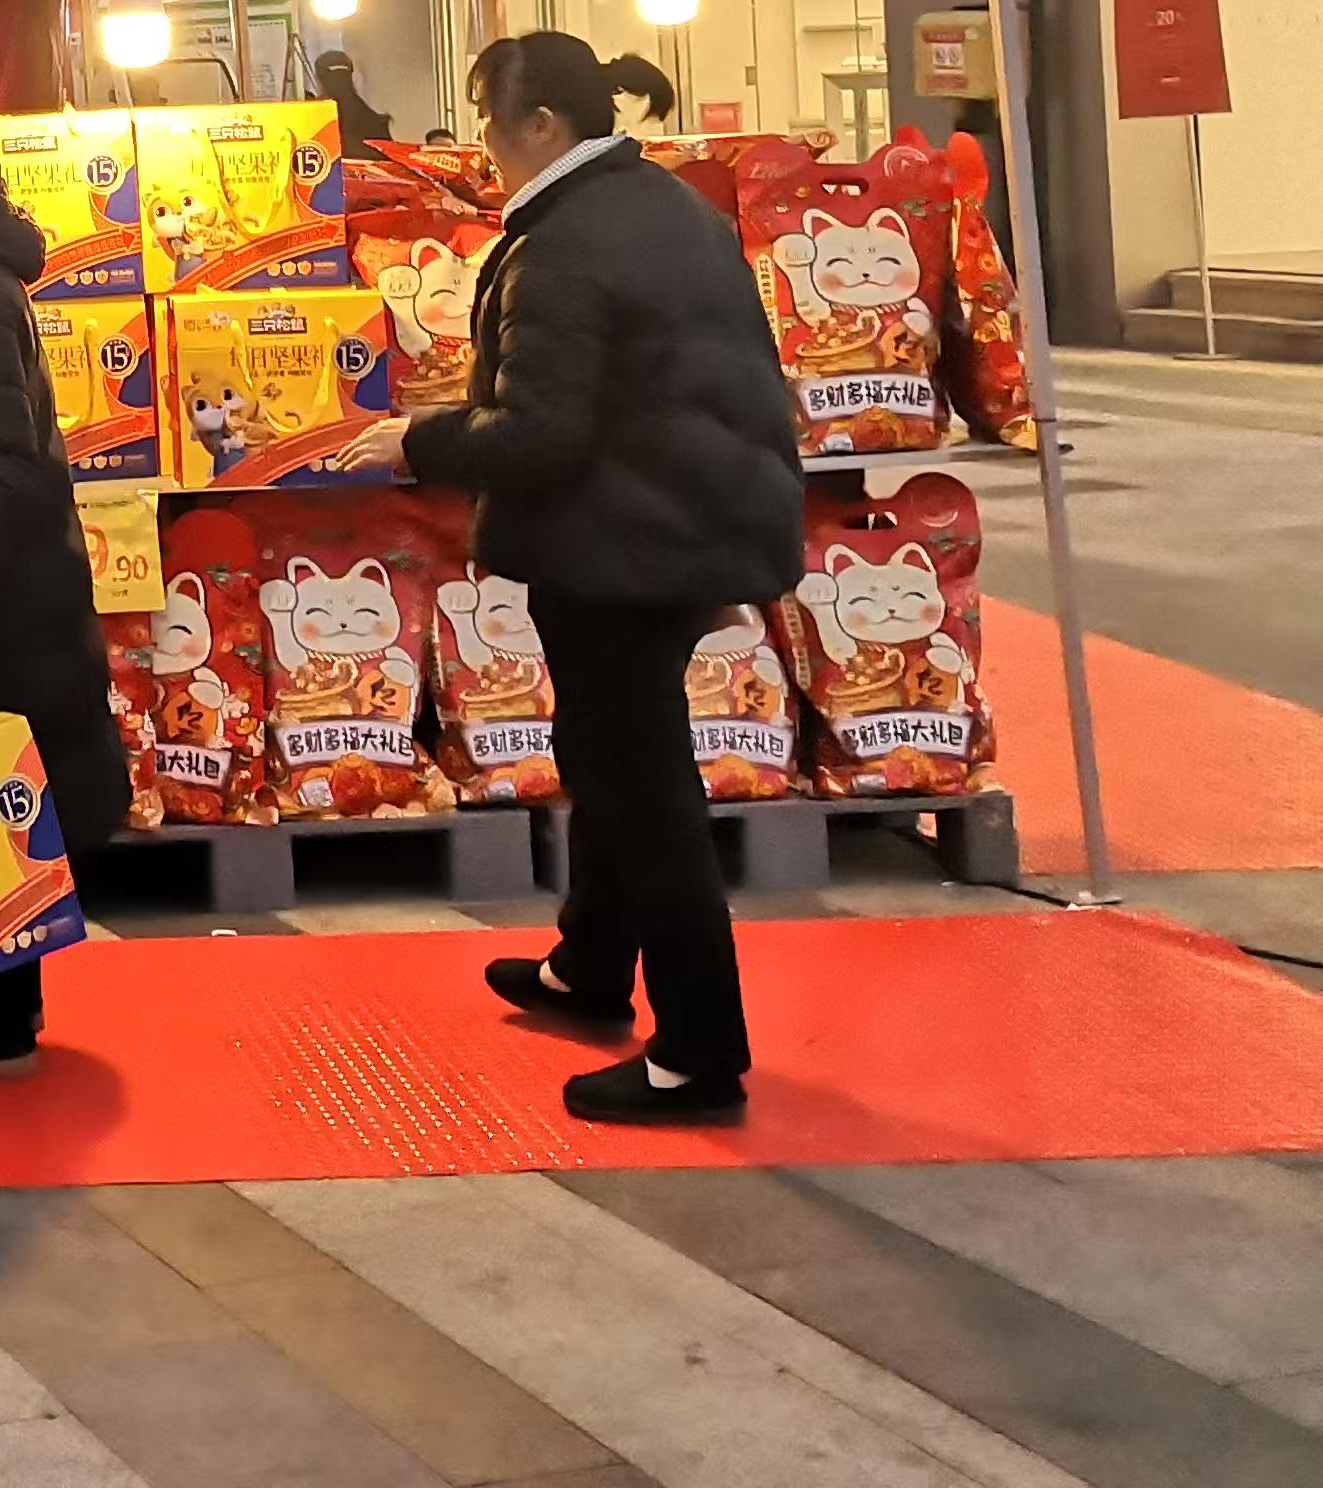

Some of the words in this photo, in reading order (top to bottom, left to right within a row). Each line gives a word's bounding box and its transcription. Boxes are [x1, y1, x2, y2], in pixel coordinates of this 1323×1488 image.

[89, 160, 115, 189] 15
[297, 151, 321, 178] 15
[250, 318, 306, 333] 三只松鼠
[104, 344, 128, 370] 15
[339, 345, 364, 371] 15
[808, 381, 933, 410] 多财多福大礼包
[287, 726, 414, 758] 多财多福大礼包
[842, 717, 963, 749] 多财多福大礼包
[0, 785, 30, 822] 15
